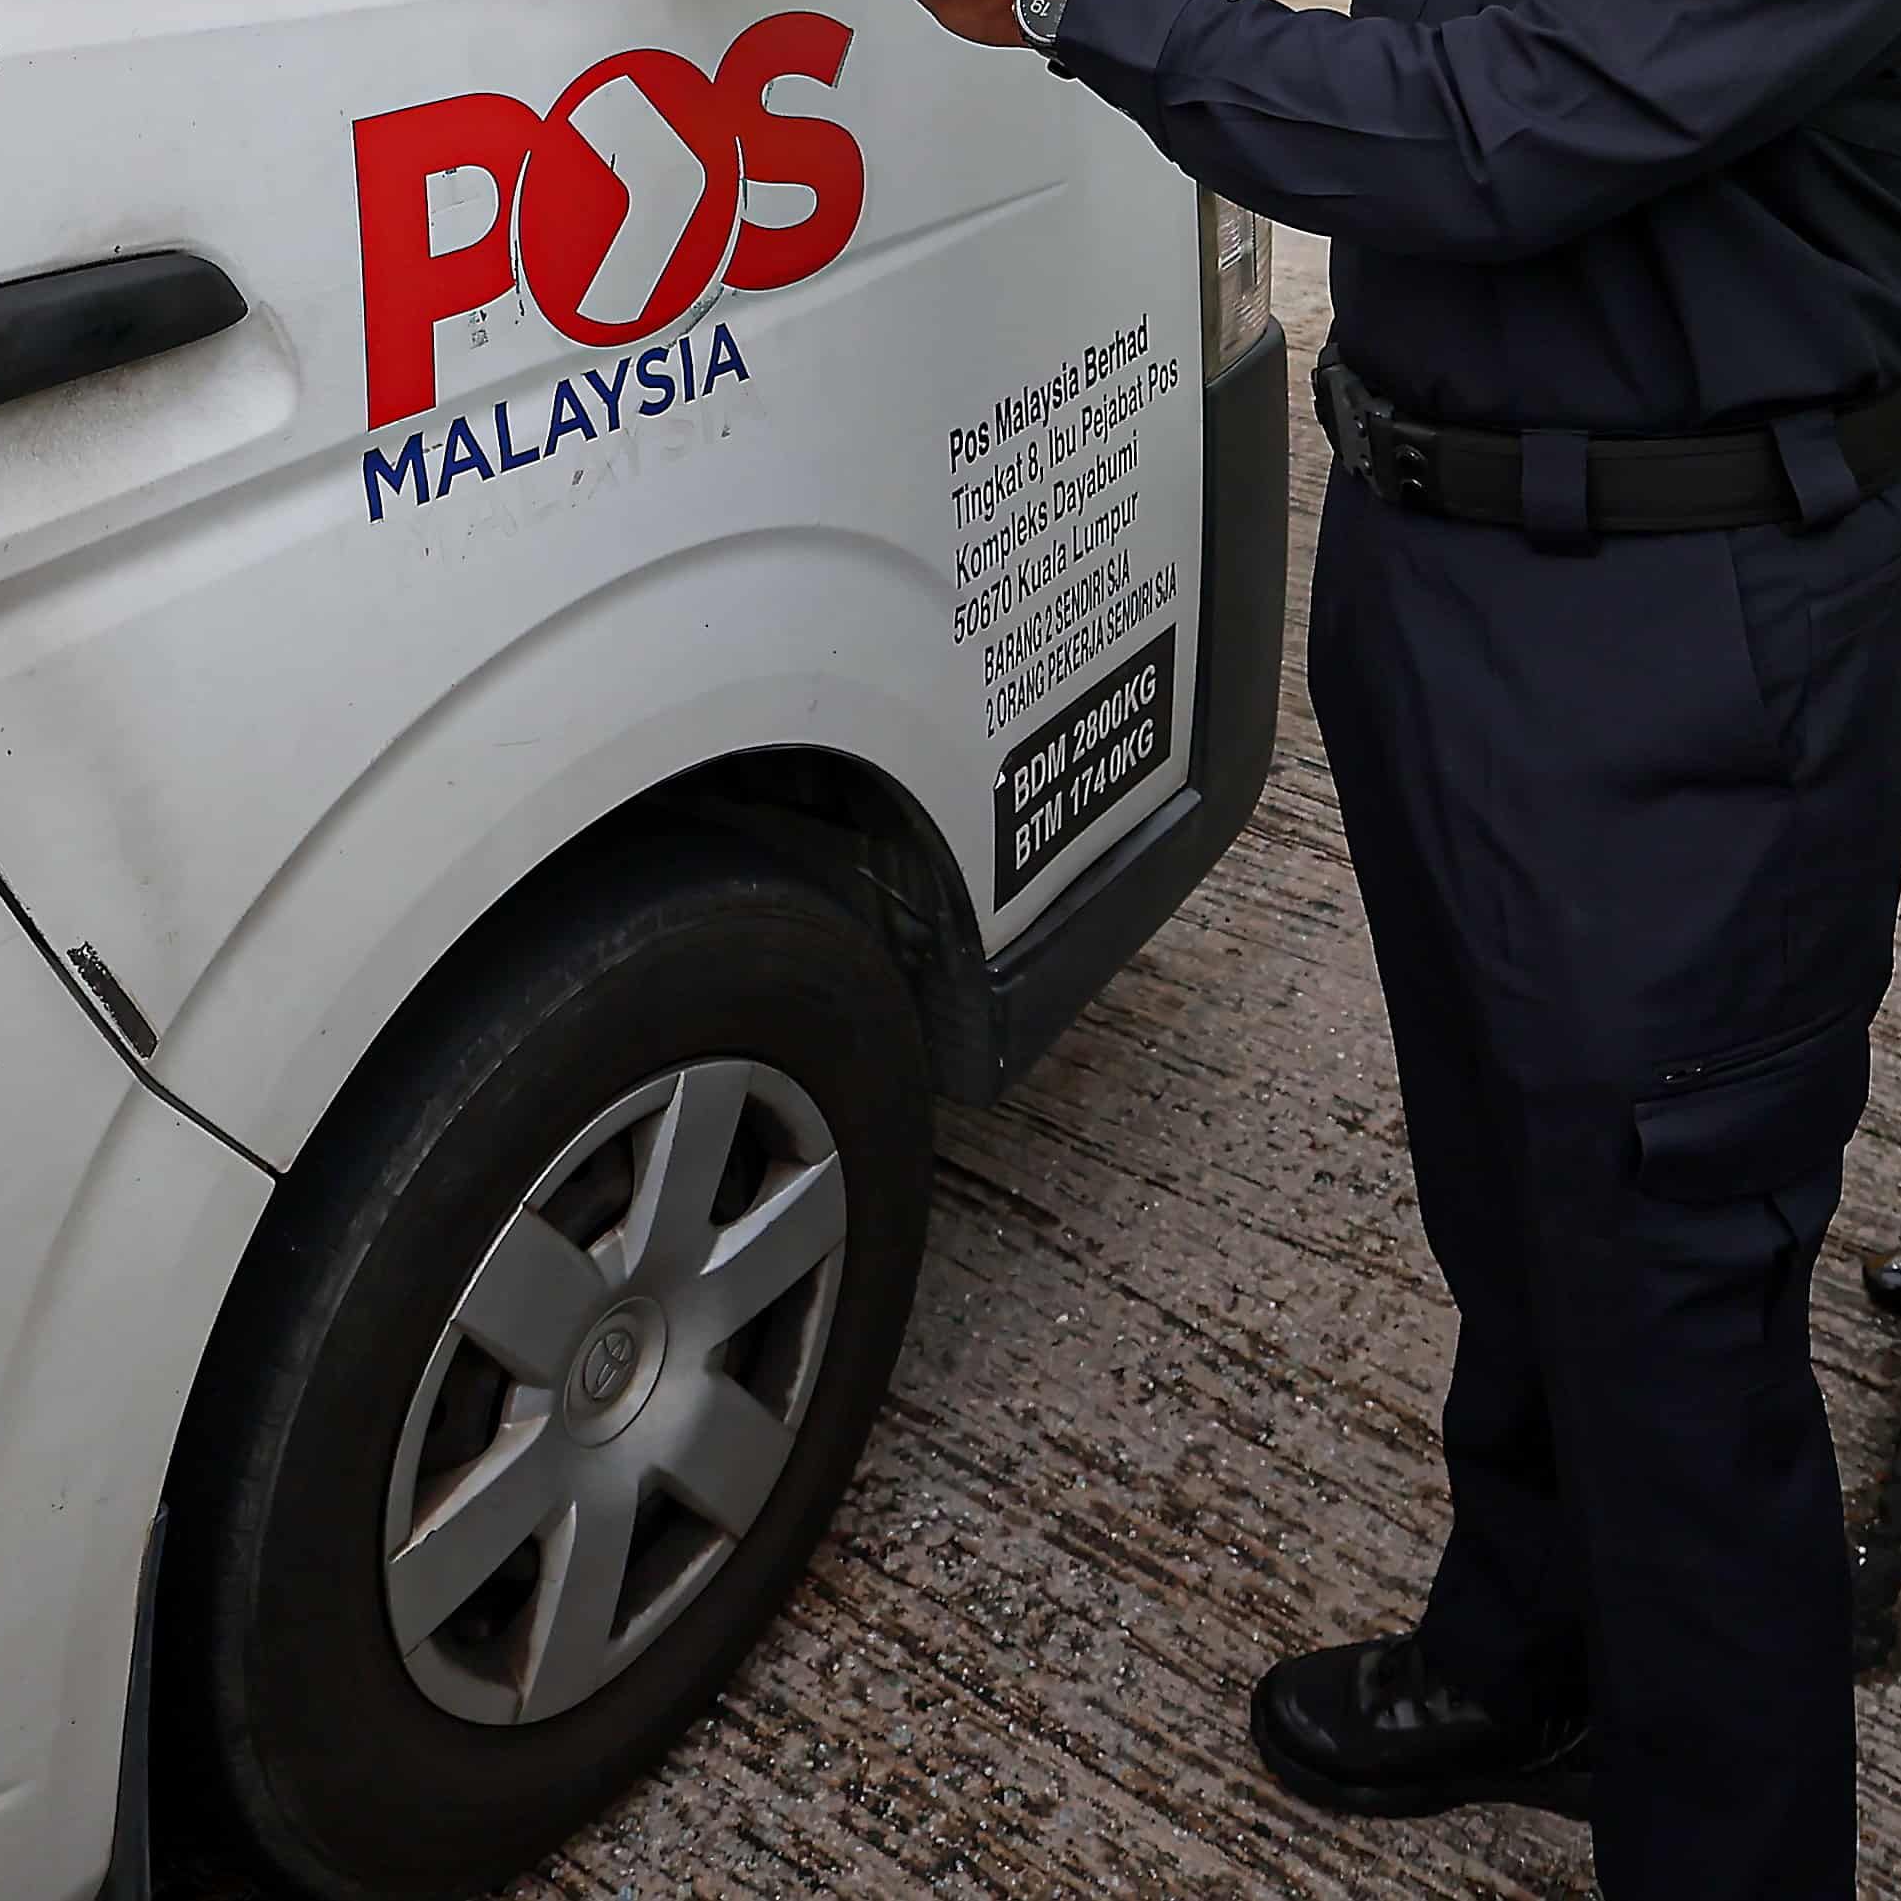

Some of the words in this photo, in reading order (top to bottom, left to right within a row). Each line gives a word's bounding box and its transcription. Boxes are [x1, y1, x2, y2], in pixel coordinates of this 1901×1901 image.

[351, 10, 865, 433] POS
[362, 322, 751, 524] MALAYSIA
[949, 421, 989, 475] Pos
[995, 362, 1079, 446] Malaysia
[1084, 313, 1148, 389] Berhad
[951, 451, 1023, 530] Tingkat
[1028, 441, 1044, 484] 8,
[1049, 425, 1076, 468] Ibu
[1082, 375, 1144, 447] Pejabat
[1148, 358, 1178, 403] Pos
[954, 575, 1012, 645] 50670
[1018, 539, 1067, 604] Kuala
[1072, 491, 1138, 563] Lumpur
[956, 500, 1048, 590] Kompleks
[1053, 429, 1138, 522] Dayabumi
[984, 611, 1042, 687] BARANG
[1045, 604, 1053, 643] 2
[1055, 566, 1104, 635] SENDIRI
[1107, 548, 1130, 597] SJA
[986, 697, 995, 739] 2
[997, 659, 1044, 728] ORANG
[1049, 615, 1103, 691] PEKERJA
[1106, 577, 1153, 645] SENDIRI
[1155, 561, 1177, 609] SJA
[1014, 733, 1066, 814] BDM
[1072, 663, 1156, 763] 2800KG
[1015, 791, 1063, 870] BTM
[1070, 718, 1154, 816] 1740KG
